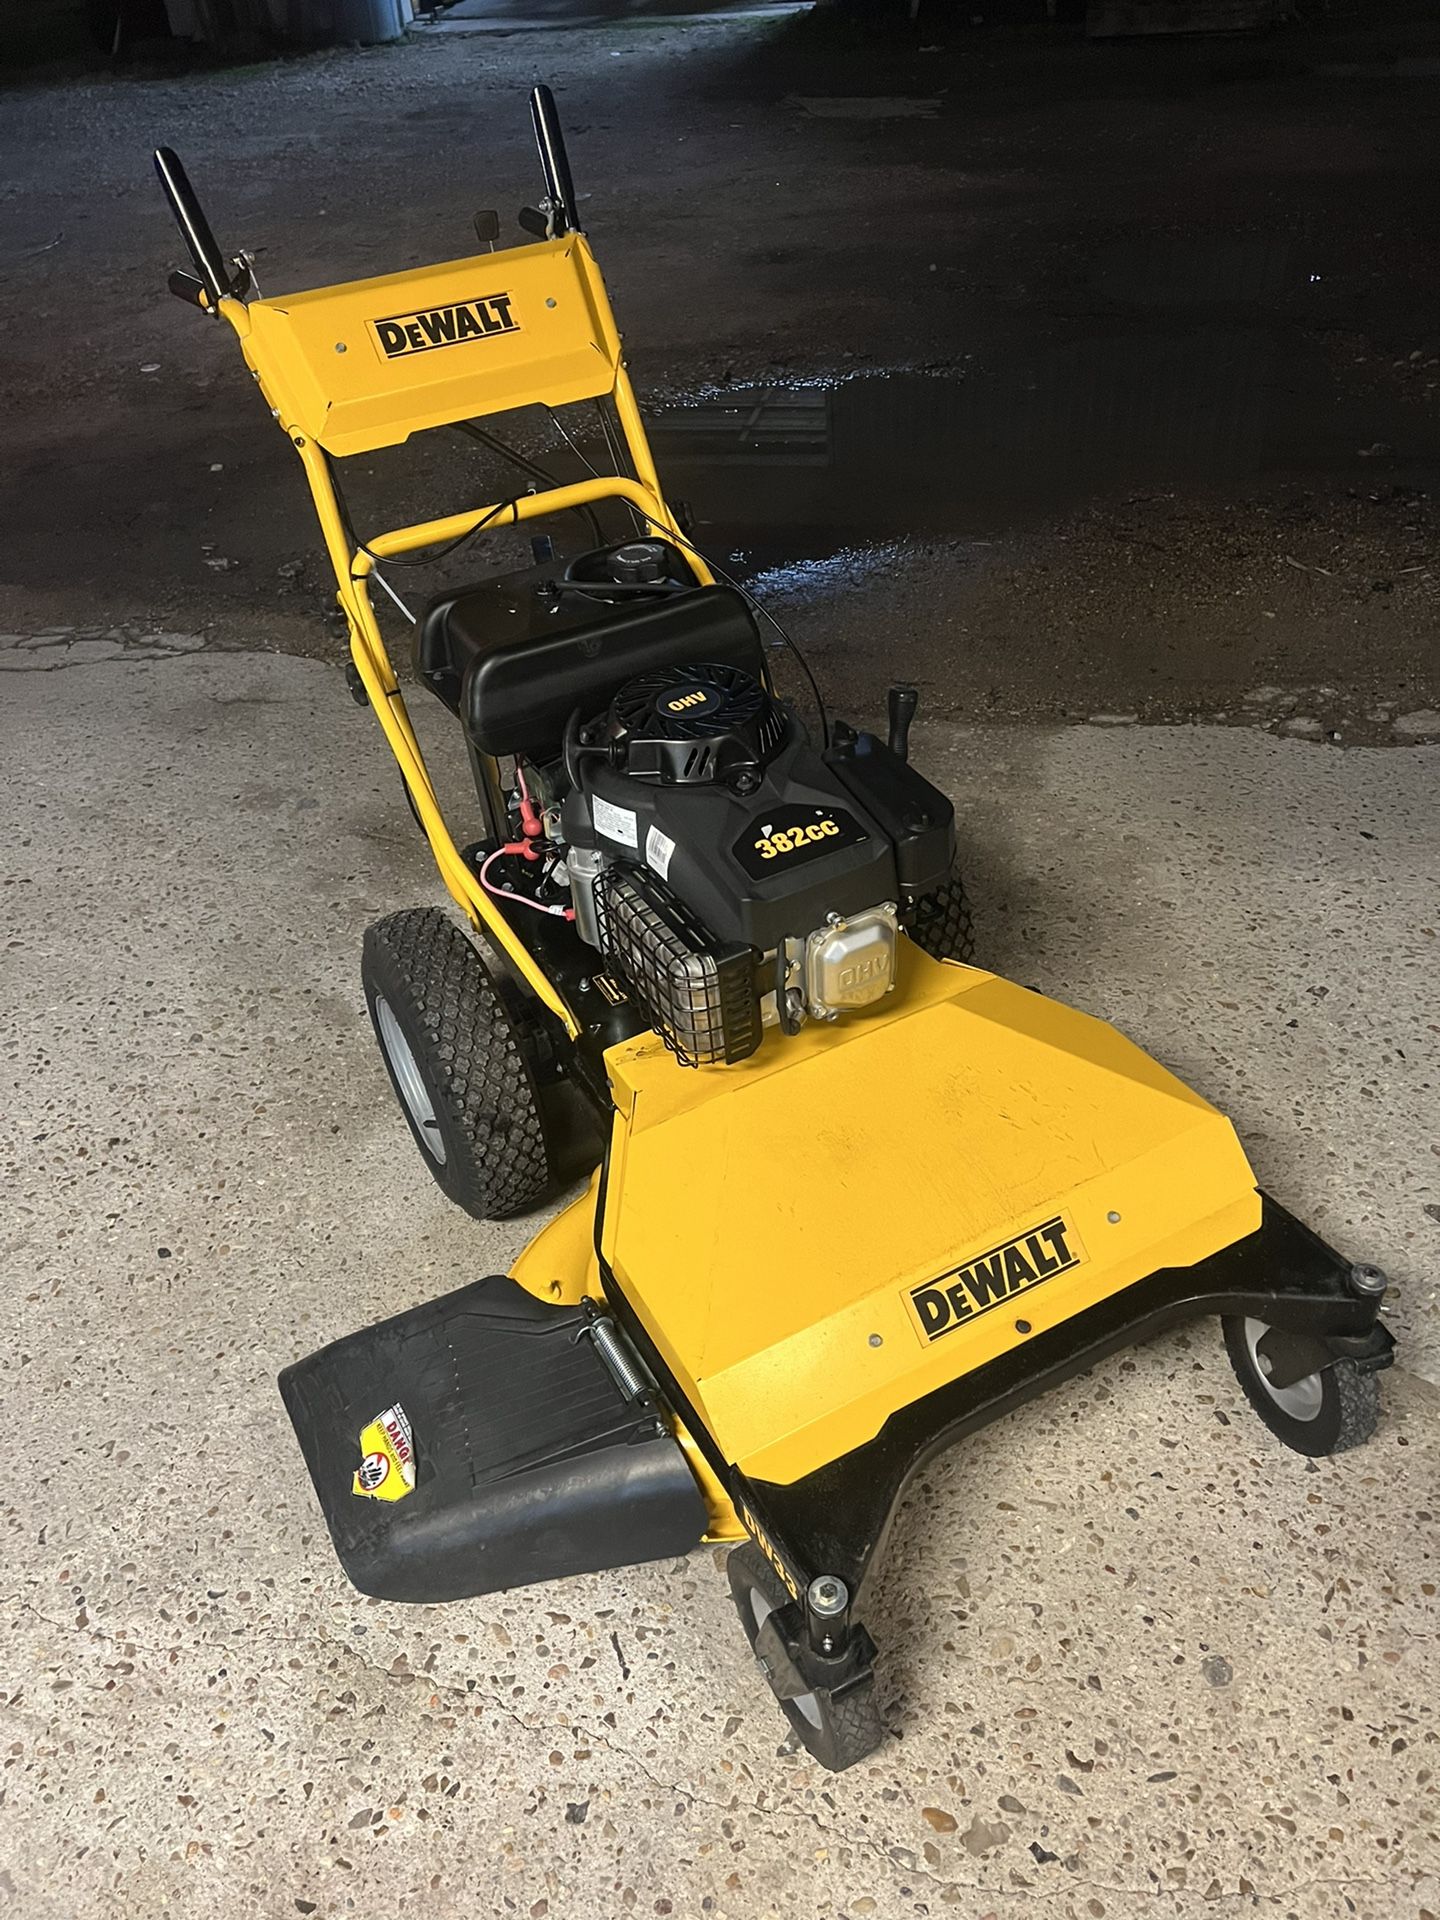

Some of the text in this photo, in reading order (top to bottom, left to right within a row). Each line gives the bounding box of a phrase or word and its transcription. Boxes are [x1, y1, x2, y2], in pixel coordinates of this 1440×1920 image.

[668, 691, 707, 711] OHV
[754, 820, 840, 859] 382cc
[839, 954, 888, 987] OHV
